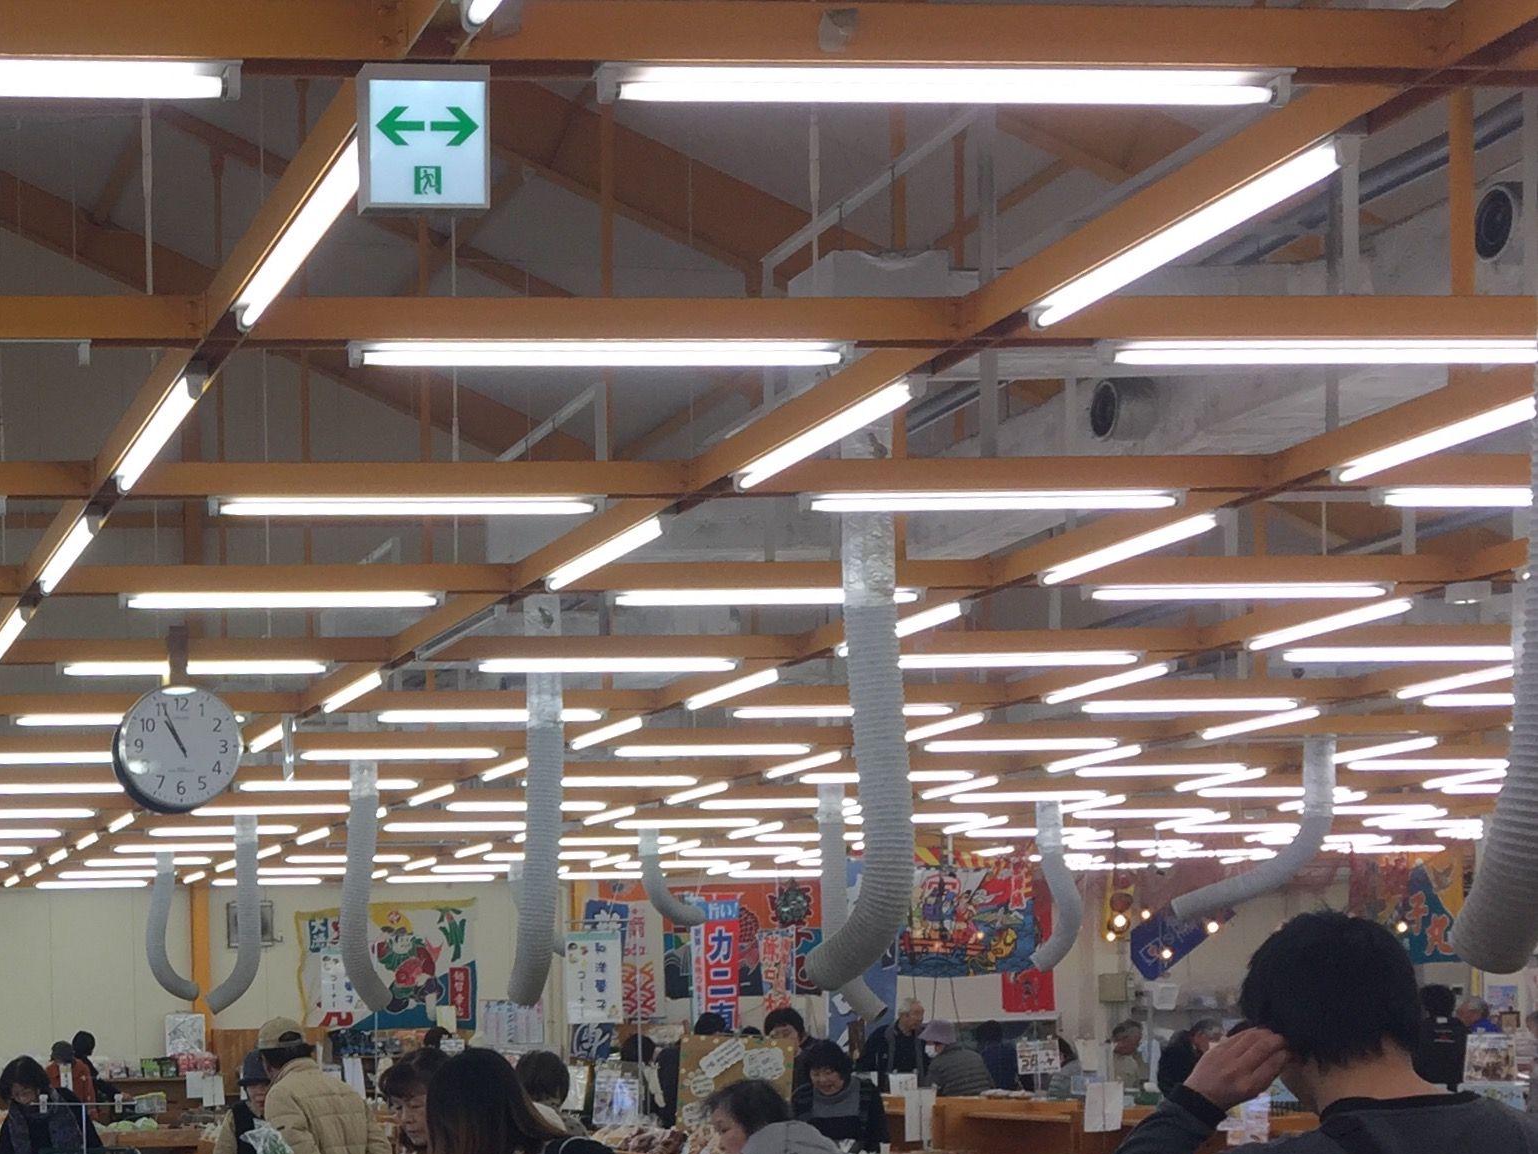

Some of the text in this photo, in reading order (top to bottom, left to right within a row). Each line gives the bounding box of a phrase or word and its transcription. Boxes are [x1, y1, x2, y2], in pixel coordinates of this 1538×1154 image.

[174, 697, 190, 712] 12
[199, 703, 205, 717] 1
[140, 718, 156, 733] 10
[213, 718, 222, 733] 2
[134, 738, 144, 753] 9
[219, 739, 228, 754] 3
[212, 760, 222, 775] 4
[156, 775, 165, 790] 7
[176, 781, 186, 795] 6
[197, 776, 207, 791] 5
